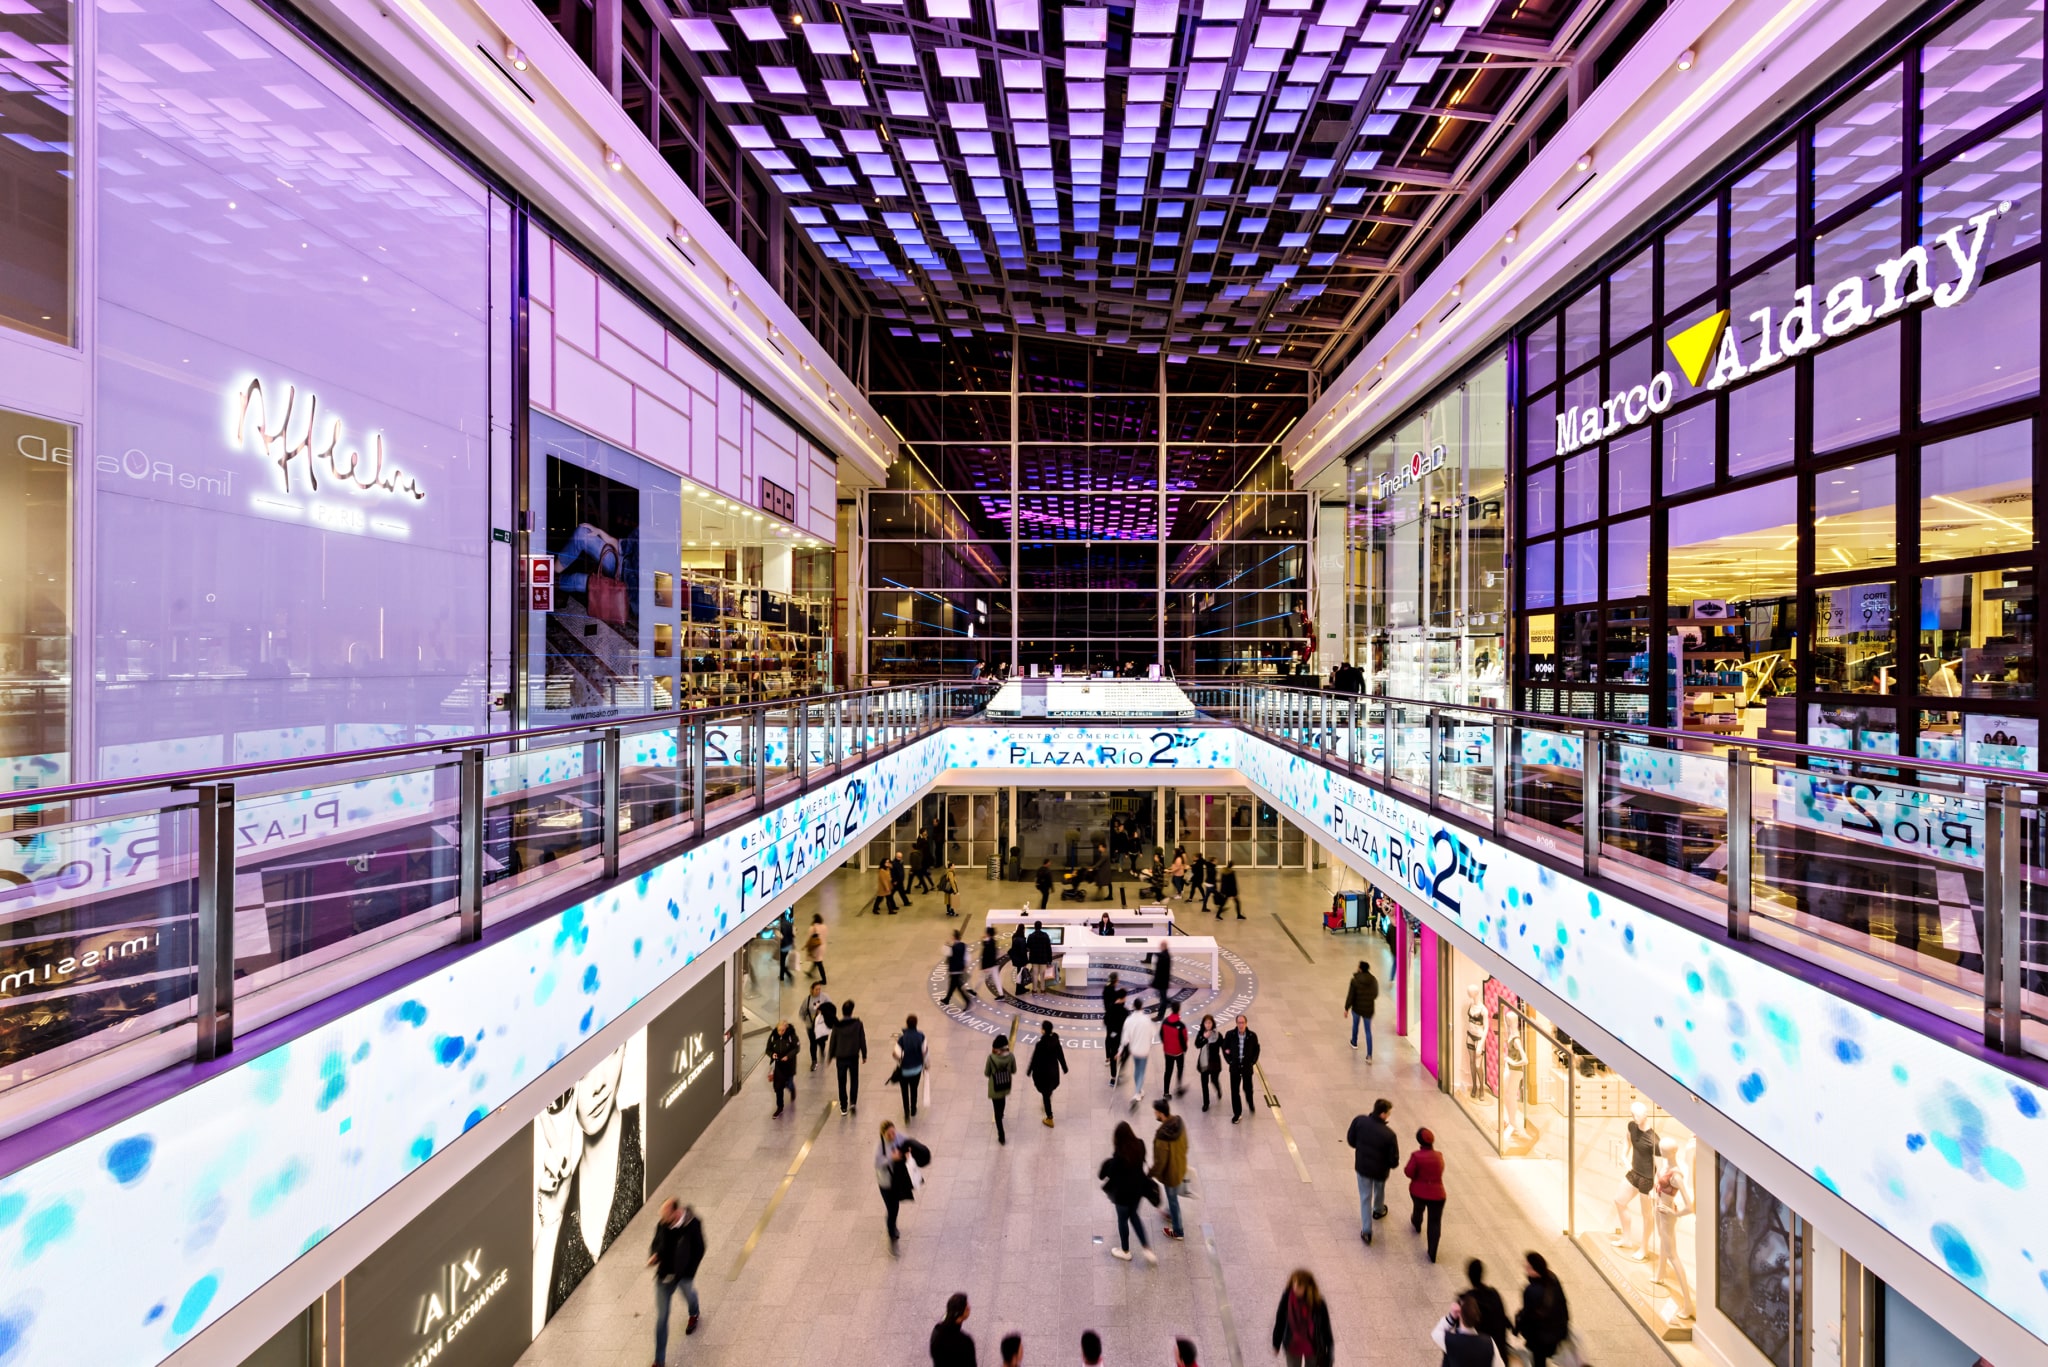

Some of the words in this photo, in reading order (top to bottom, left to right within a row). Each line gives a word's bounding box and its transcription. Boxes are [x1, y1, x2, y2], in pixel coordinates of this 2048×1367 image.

[1555, 370, 1678, 457] Marco
[1707, 207, 1998, 391] Aldany
[317, 505, 365, 529] PARIS
[1863, 591, 1888, 600] CORTE
[1863, 609, 1872, 624] 9
[570, 709, 619, 721] www.misako.com
[1009, 732, 1060, 740] CENTRO
[1068, 732, 1142, 740] COMERCIAL
[1010, 746, 1085, 765] PLAZA
[793, 792, 841, 823] COMERCIAL
[1332, 780, 1364, 806] CENTRO
[1366, 797, 1426, 836] COMERCIAL
[1334, 804, 1380, 858] PLAZA
[740, 845, 806, 914] PLAZA
[447, 1268, 509, 1343] EXCHANGE
